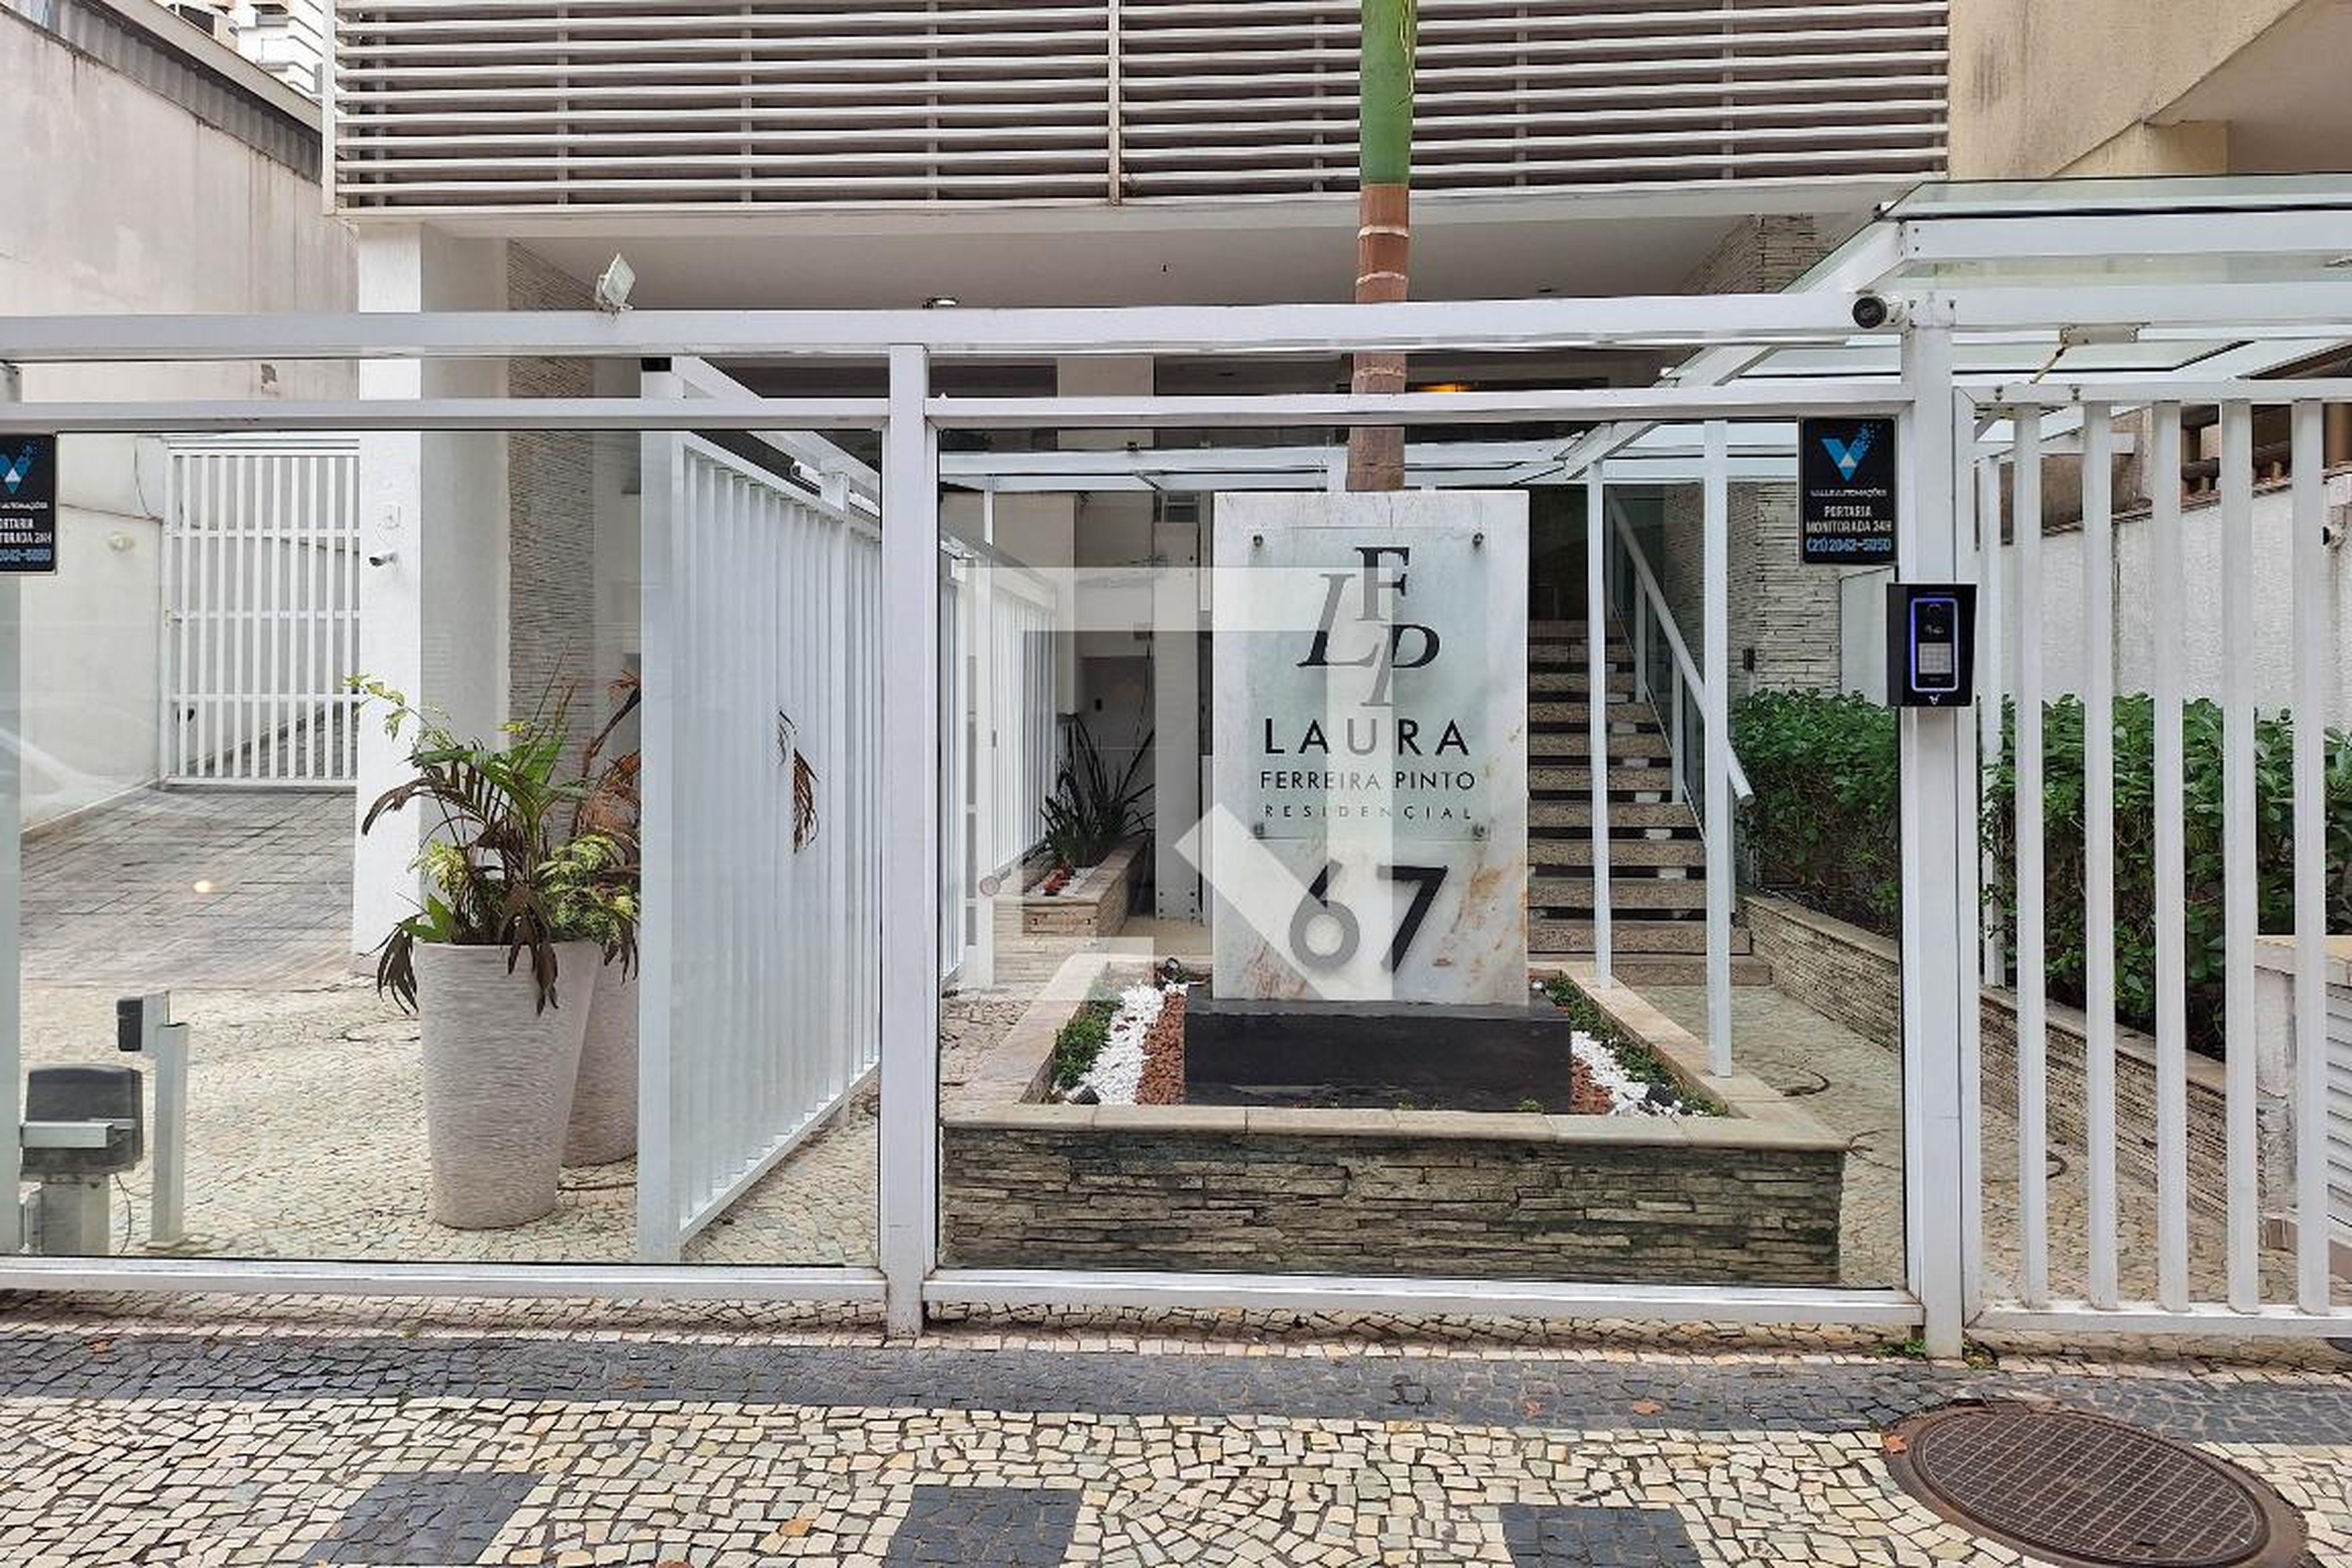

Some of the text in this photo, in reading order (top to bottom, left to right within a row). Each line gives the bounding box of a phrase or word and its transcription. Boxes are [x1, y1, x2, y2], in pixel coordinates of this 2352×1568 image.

[1824, 505, 1872, 518] PORTARIA
[1806, 520, 1893, 534] MONITORADA 24H
[1806, 537, 1828, 553] (21)
[1265, 718, 1469, 756] LAURA
[1261, 771, 1475, 791] FERREIRA PINTO
[1265, 805, 1471, 820] RESIDENCIAL
[1289, 860, 1449, 973] 67
